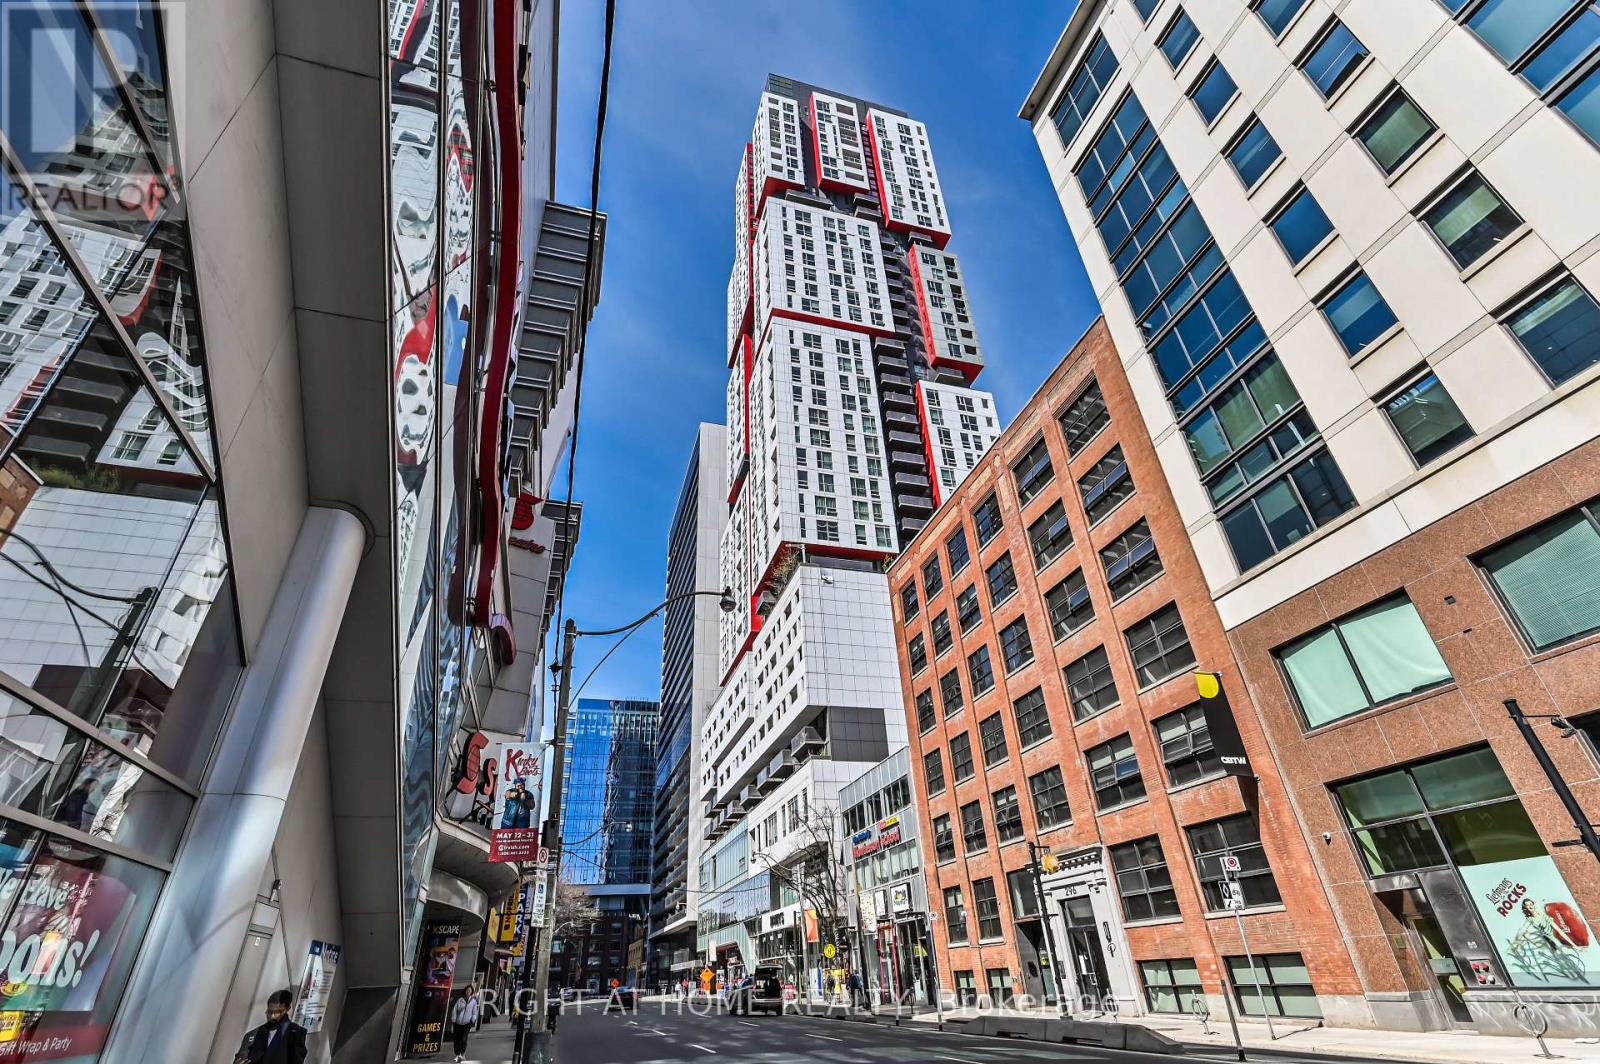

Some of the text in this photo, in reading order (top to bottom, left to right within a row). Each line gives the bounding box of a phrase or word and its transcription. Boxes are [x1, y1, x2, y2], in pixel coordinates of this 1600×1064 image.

[505, 748, 539, 781] Kinky
[519, 764, 542, 777] Boots
[1064, 886, 1077, 897] 296
[1496, 883, 1527, 917] ROCKS
[513, 893, 526, 934] PARK
[417, 1022, 441, 1033] GAMES
[424, 1034, 431, 1042] &
[18, 1039, 42, 1055] Wrap
[42, 1038, 50, 1051] &
[50, 1035, 73, 1052] Party
[412, 1042, 439, 1053] PRIZES
